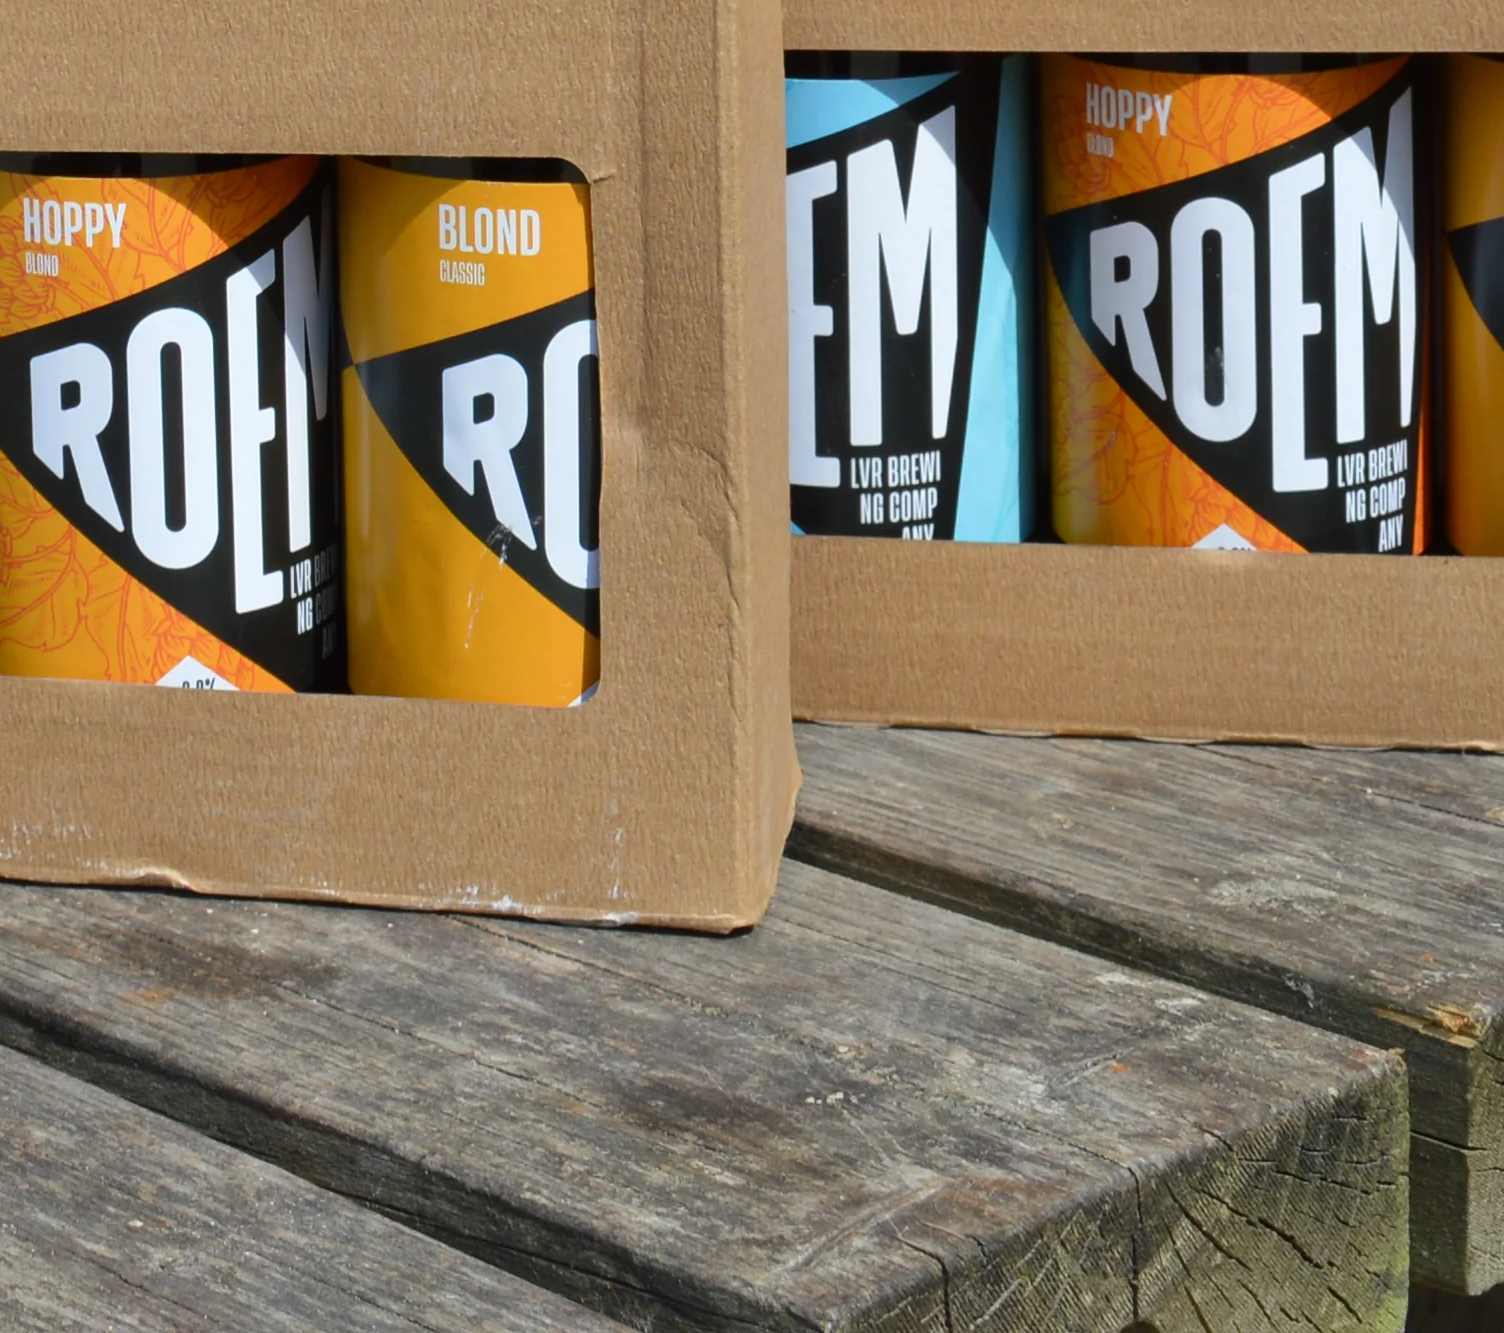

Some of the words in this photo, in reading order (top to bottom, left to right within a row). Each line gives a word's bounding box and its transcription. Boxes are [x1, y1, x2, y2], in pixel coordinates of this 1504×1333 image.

[1086, 82, 1173, 137] HOPPY
[22, 197, 127, 250] HOPPY
[439, 202, 541, 257] BLOND
[25, 251, 60, 278] BLOND
[439, 259, 486, 287] CLASSIC
[1090, 85, 1417, 493] ROEM
[442, 319, 600, 590] RO
[851, 455, 883, 489] LVR
[887, 450, 942, 488] BREWI
[1337, 453, 1366, 488] LVR
[1369, 439, 1408, 484] BREWI
[860, 492, 885, 525] NG
[889, 486, 938, 523] COMP
[1345, 488, 1367, 524] NG
[1370, 478, 1406, 520] COMP
[1378, 513, 1404, 553] ANY
[290, 558, 312, 600] LVR
[297, 596, 313, 635] NG
